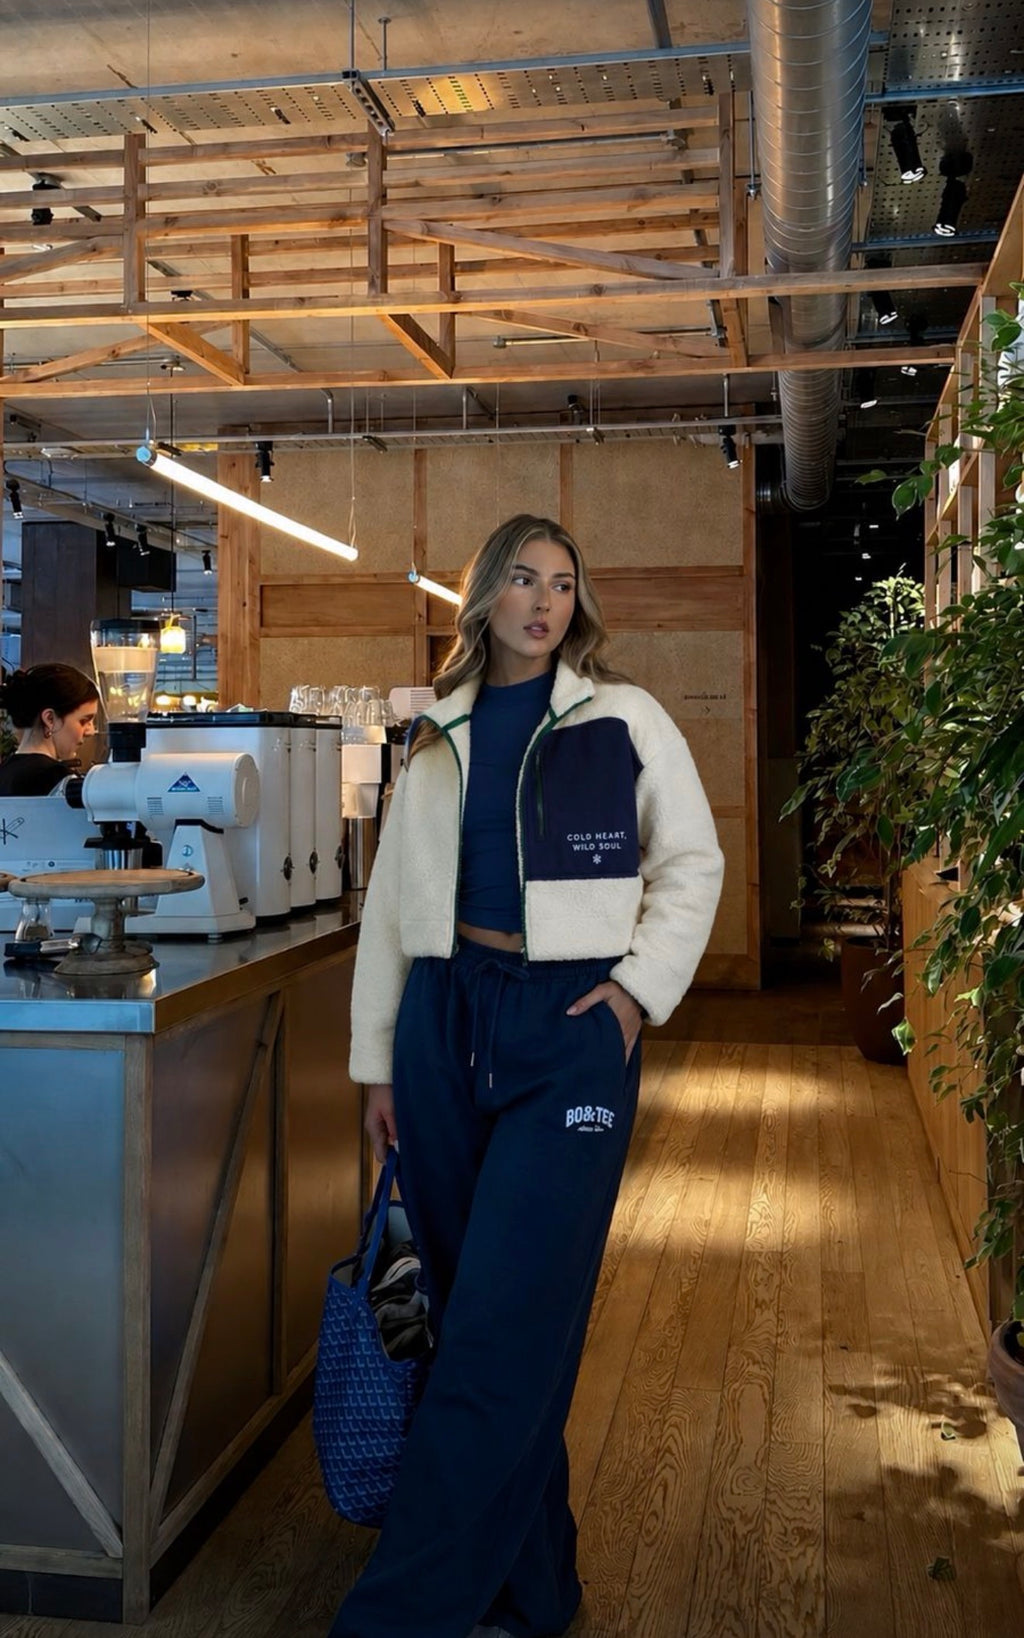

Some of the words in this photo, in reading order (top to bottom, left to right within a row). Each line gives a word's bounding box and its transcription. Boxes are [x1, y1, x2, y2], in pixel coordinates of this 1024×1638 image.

[566, 833, 592, 841] COLD
[595, 831, 628, 840] HEART,
[572, 843, 596, 851] WILD
[598, 842, 622, 850] SOUL
[565, 1105, 615, 1128] BO&TEE
